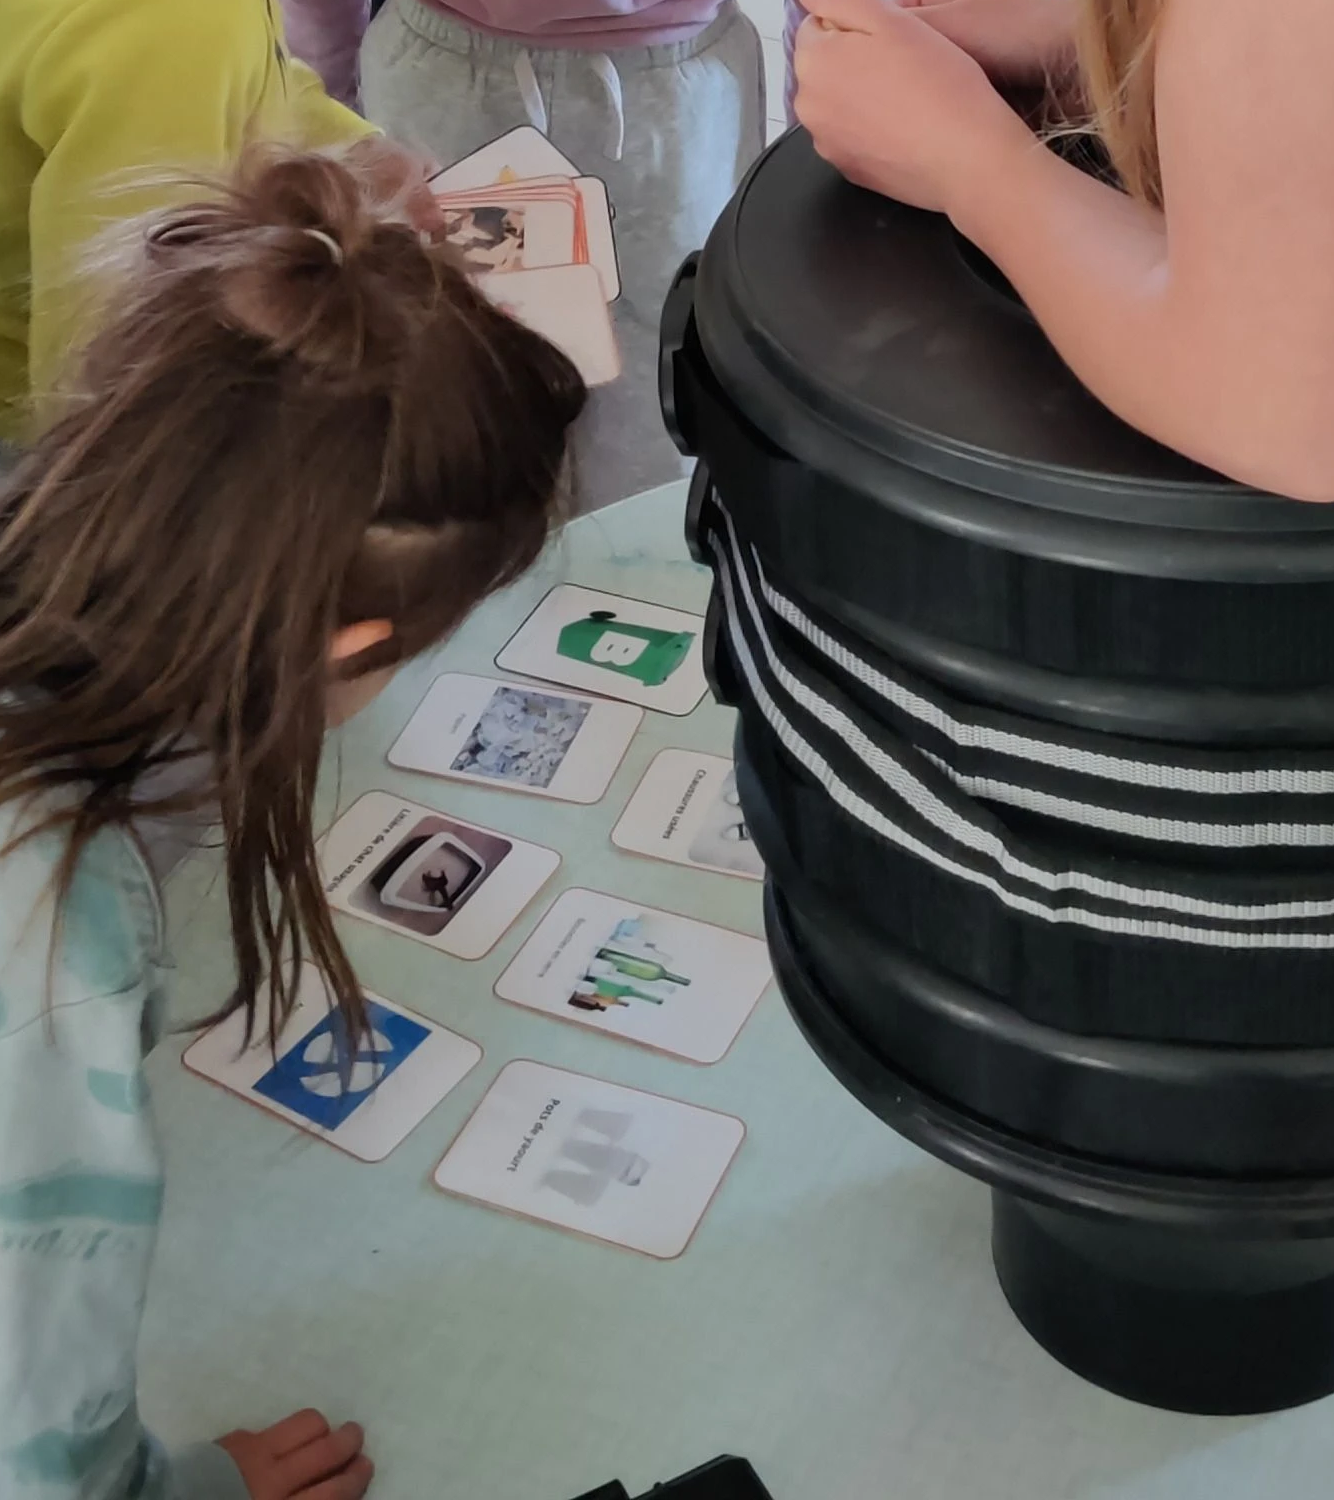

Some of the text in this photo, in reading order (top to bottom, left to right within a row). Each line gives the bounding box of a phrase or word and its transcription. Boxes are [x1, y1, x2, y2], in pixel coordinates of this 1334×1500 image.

[589, 629, 651, 667] B
[370, 833, 385, 845] de
[506, 1098, 561, 1172] Pots de yaourt
